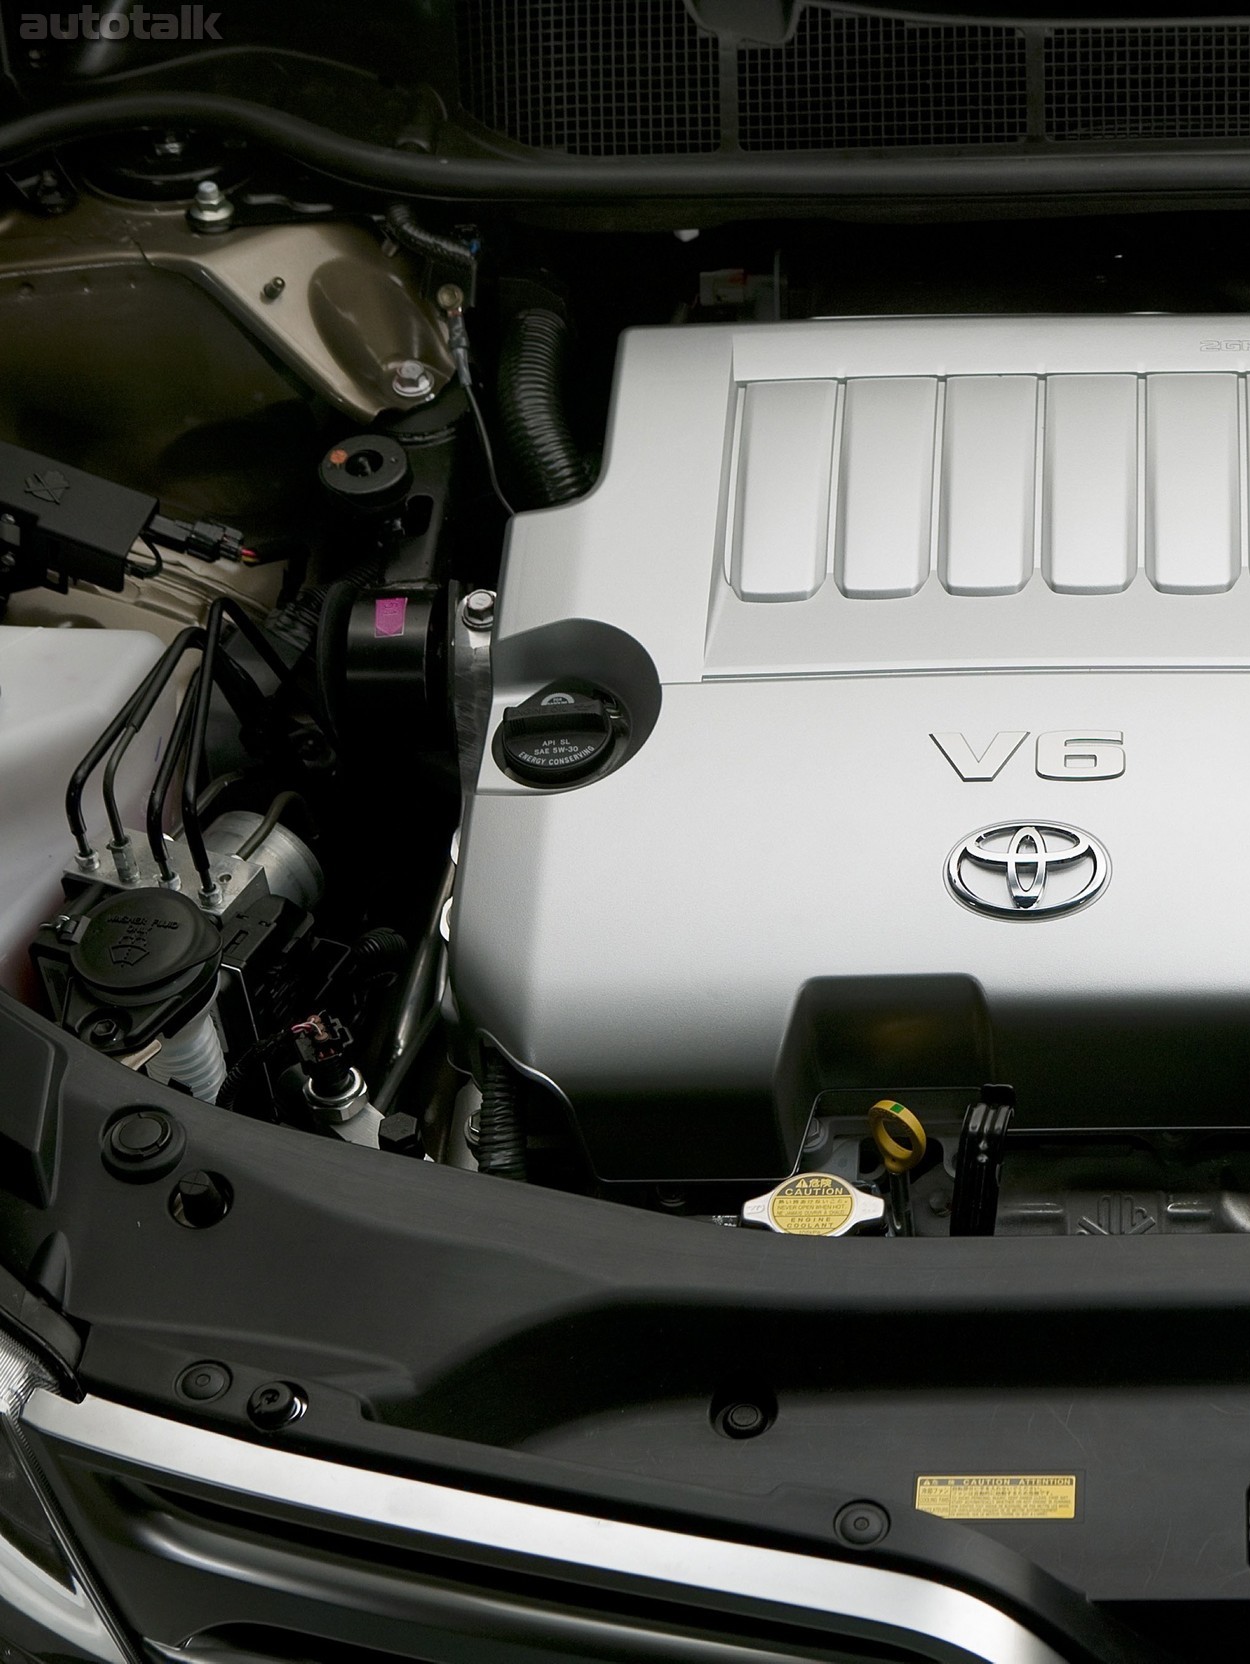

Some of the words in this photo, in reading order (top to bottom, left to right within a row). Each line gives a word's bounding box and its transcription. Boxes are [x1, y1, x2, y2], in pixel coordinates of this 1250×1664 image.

[519, 751, 546, 765] ENERGY
[549, 745, 594, 765] CONSERVING
[928, 730, 1126, 782] V6
[785, 1187, 843, 1196] CAUTION
